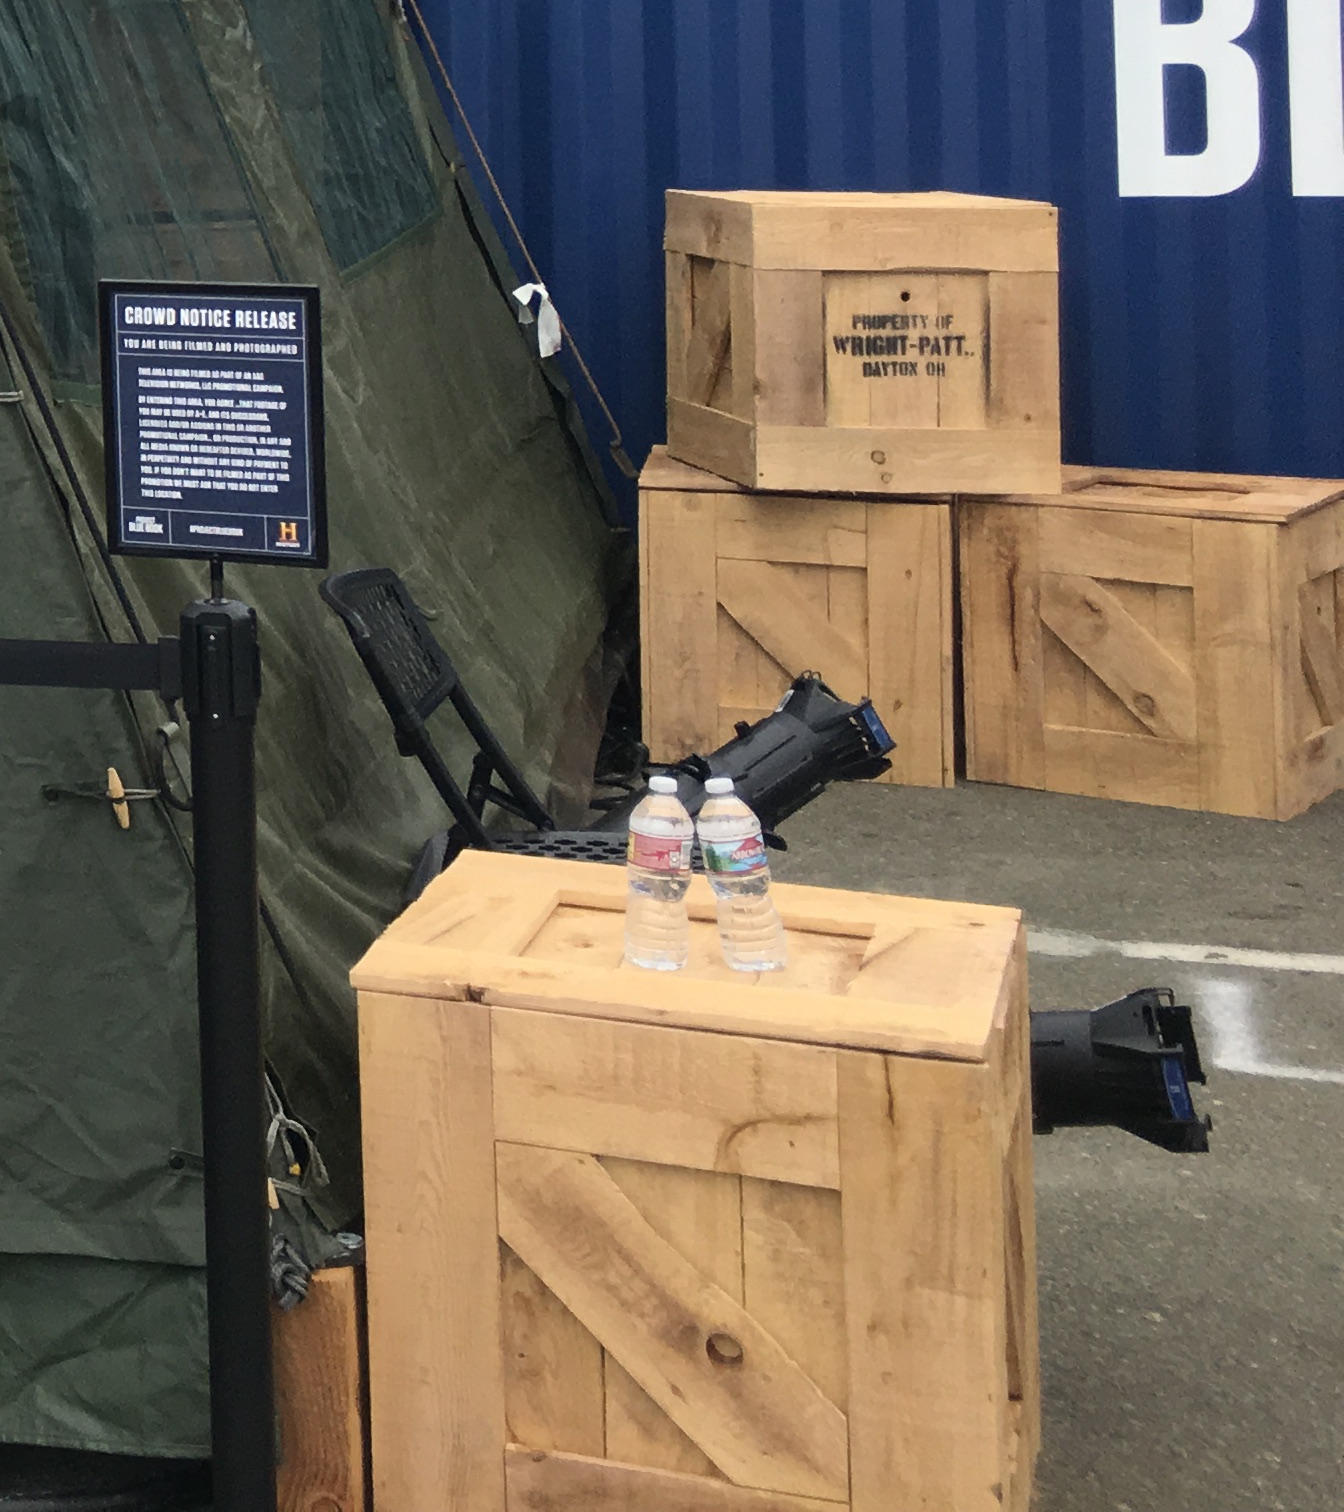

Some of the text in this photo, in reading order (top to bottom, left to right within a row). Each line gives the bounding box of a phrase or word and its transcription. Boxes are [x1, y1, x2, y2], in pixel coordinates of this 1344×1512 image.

[124, 306, 297, 330] CROWD NOTICE RELEASE
[852, 314, 954, 331] PROPERTY OF
[123, 338, 140, 349] YOU
[141, 339, 156, 350] ARE
[184, 341, 213, 352] FILMED
[233, 343, 298, 355] PHOTOGRAPHED
[862, 361, 946, 378] DAYTON OH
